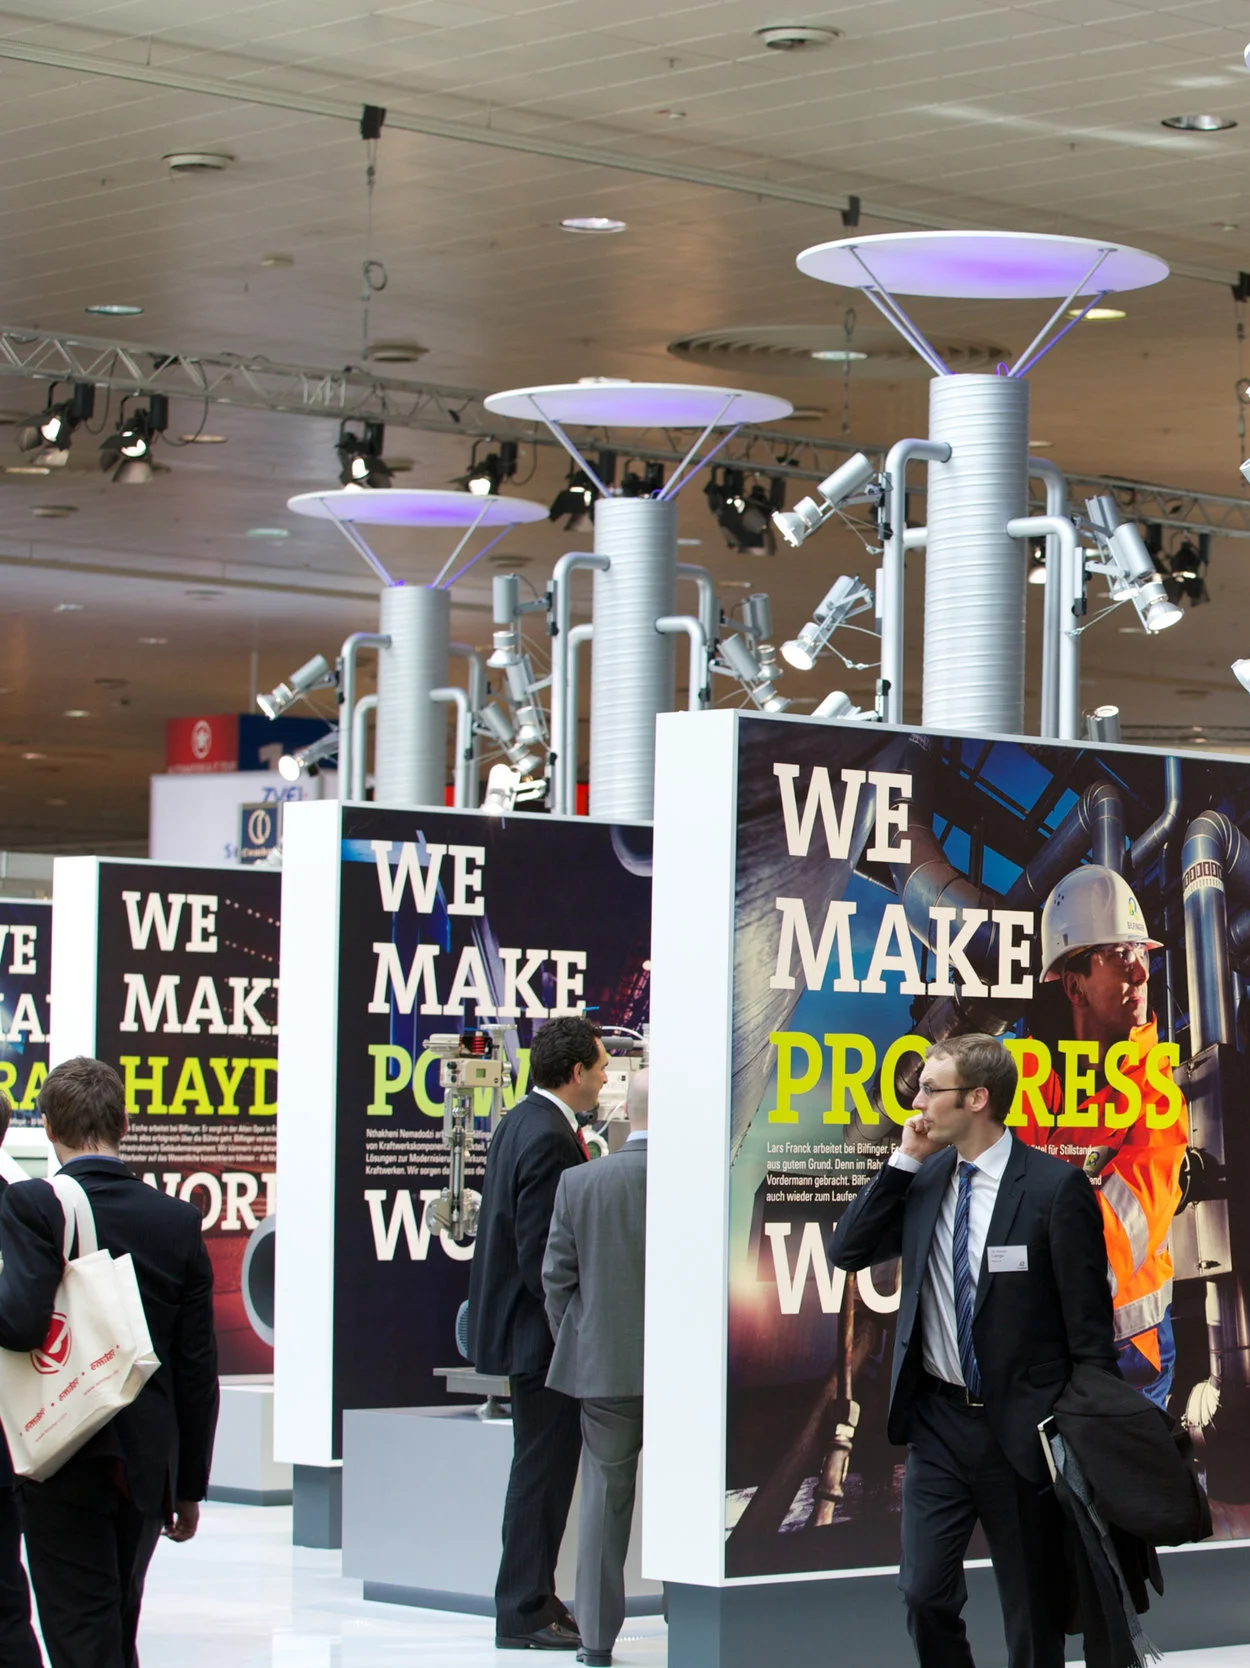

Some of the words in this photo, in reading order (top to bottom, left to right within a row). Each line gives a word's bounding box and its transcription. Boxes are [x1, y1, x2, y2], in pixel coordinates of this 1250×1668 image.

[772, 762, 913, 864] WE
[370, 839, 486, 917] WE
[121, 890, 219, 953] WE
[769, 897, 1036, 1000] MAKE
[367, 942, 588, 1019] MAKE
[119, 1055, 278, 1116] HAYD
[767, 1031, 1183, 1130] PRORESS
[365, 1142, 378, 1150] von
[766, 1142, 784, 1154] Lars
[785, 1142, 812, 1154] Franck
[813, 1142, 842, 1154] arbeitet
[844, 1143, 856, 1154] bei
[857, 1143, 889, 1157] Bilfinger.
[1048, 1144, 1059, 1154] für
[365, 1153, 397, 1164] Lösungen
[398, 1155, 408, 1163] zur
[766, 1160, 781, 1170] aus
[782, 1158, 806, 1172] gutem
[808, 1158, 833, 1170] Grund.
[835, 1159, 855, 1170] Denn
[856, 1159, 865, 1170] im
[365, 1166, 406, 1175] Kraftwerken.
[407, 1166, 418, 1175] Wir
[420, 1167, 441, 1177] sorgen
[766, 1174, 813, 1186] Vordermann
[814, 1174, 850, 1188] gebracht.
[766, 1190, 785, 1202] auch
[787, 1191, 813, 1202] wieder
[814, 1193, 830, 1202] zum
